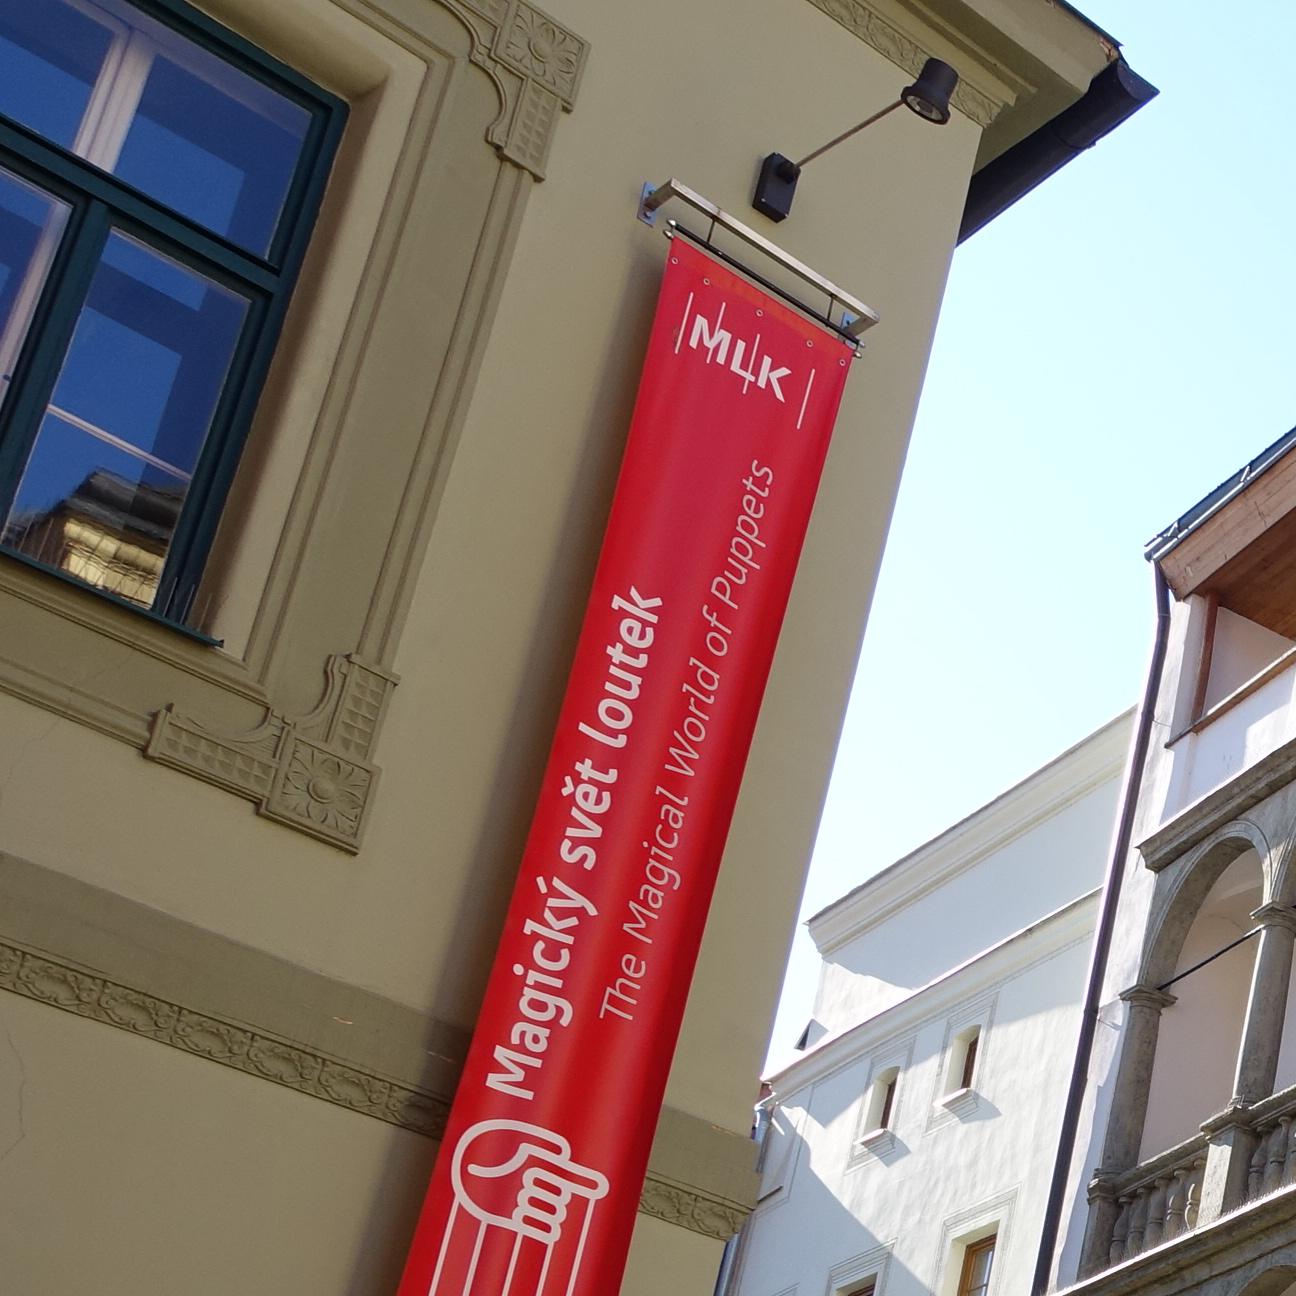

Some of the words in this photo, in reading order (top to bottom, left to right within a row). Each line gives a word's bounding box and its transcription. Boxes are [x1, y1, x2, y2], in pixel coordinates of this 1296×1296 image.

[688, 314, 792, 403] MLK
[711, 459, 774, 609] Puppets
[578, 586, 663, 748] loutek
[702, 604, 733, 657] of
[664, 656, 721, 777] World
[560, 758, 618, 871] svět
[623, 786, 688, 944] Magical
[485, 876, 598, 1100] Magický
[600, 953, 646, 1020] The
